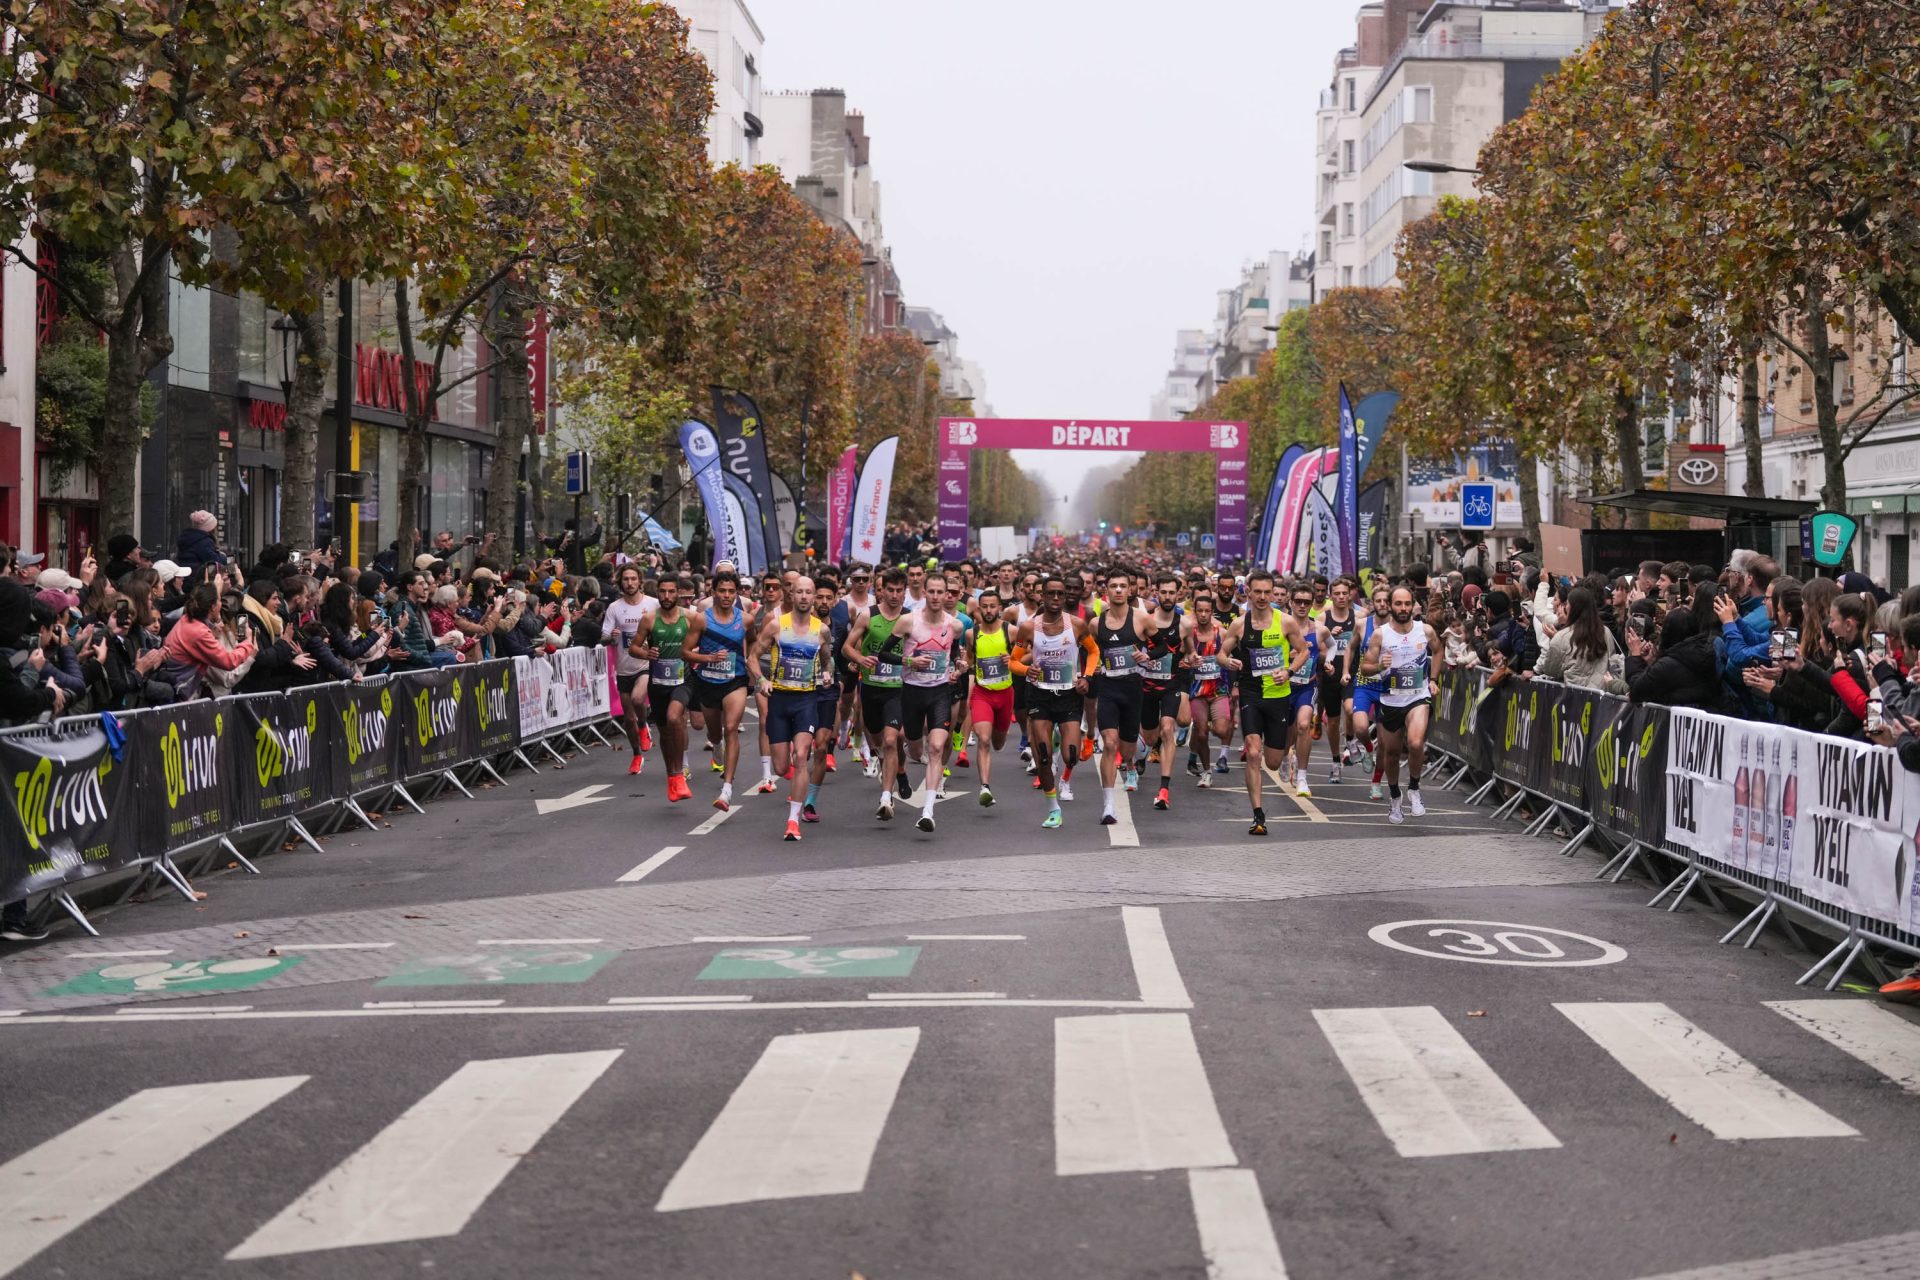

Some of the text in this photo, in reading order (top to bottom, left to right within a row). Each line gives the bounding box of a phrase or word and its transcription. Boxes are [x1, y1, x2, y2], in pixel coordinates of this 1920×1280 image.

[1052, 421, 1131, 446] DÉPART
[664, 667, 671, 677] 8
[790, 668, 802, 678] 10
[881, 663, 893, 674] 26
[988, 665, 999, 675] 21
[1114, 656, 1125, 667] 19
[1255, 655, 1279, 668] 9565
[1050, 670, 1061, 680] 16
[1402, 676, 1414, 687] 25
[432, 686, 458, 737] i-run
[358, 698, 387, 754] i-run
[182, 719, 217, 793] i-run
[275, 715, 310, 775] i-run
[1674, 715, 1725, 781] VITAMIN
[49, 754, 108, 833] i-run
[1816, 741, 1895, 823] VITAMIN
[84, 843, 110, 863] FITNESS
[1811, 813, 1852, 888] WELL
[1428, 929, 1566, 958] 30
